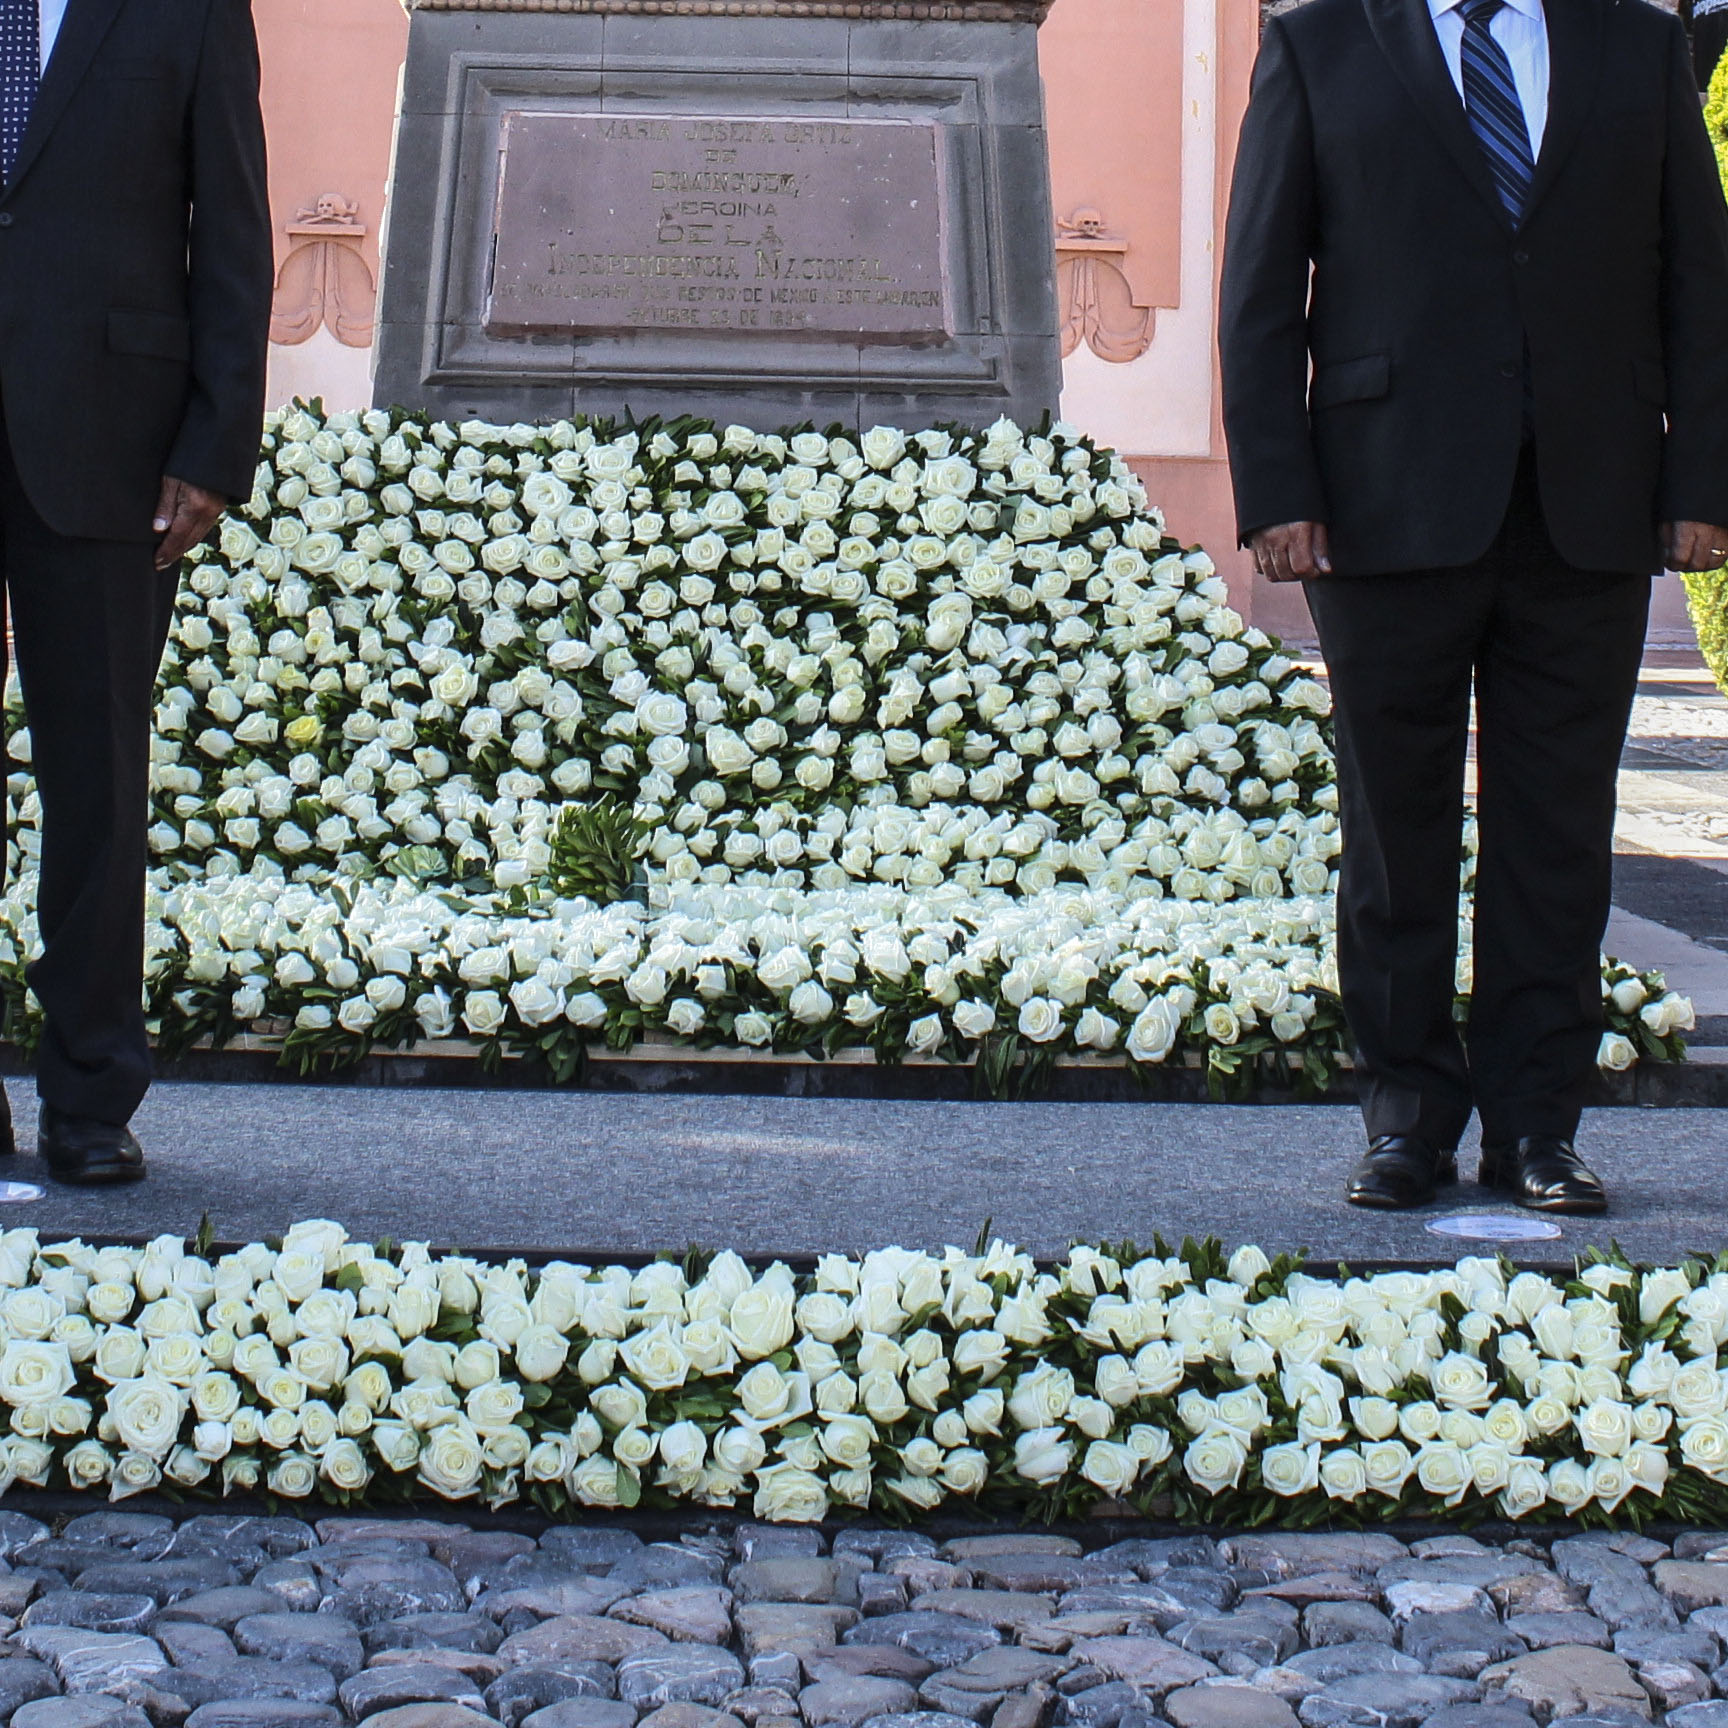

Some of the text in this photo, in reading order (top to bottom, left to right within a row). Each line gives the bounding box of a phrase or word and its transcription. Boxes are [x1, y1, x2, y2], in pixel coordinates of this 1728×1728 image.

[595, 120, 855, 145] MARIA JOSEFA ORTIZ
[704, 148, 737, 163] DE
[656, 223, 785, 247] DE LA
[743, 287, 763, 302] DE
[739, 309, 760, 326] DE
